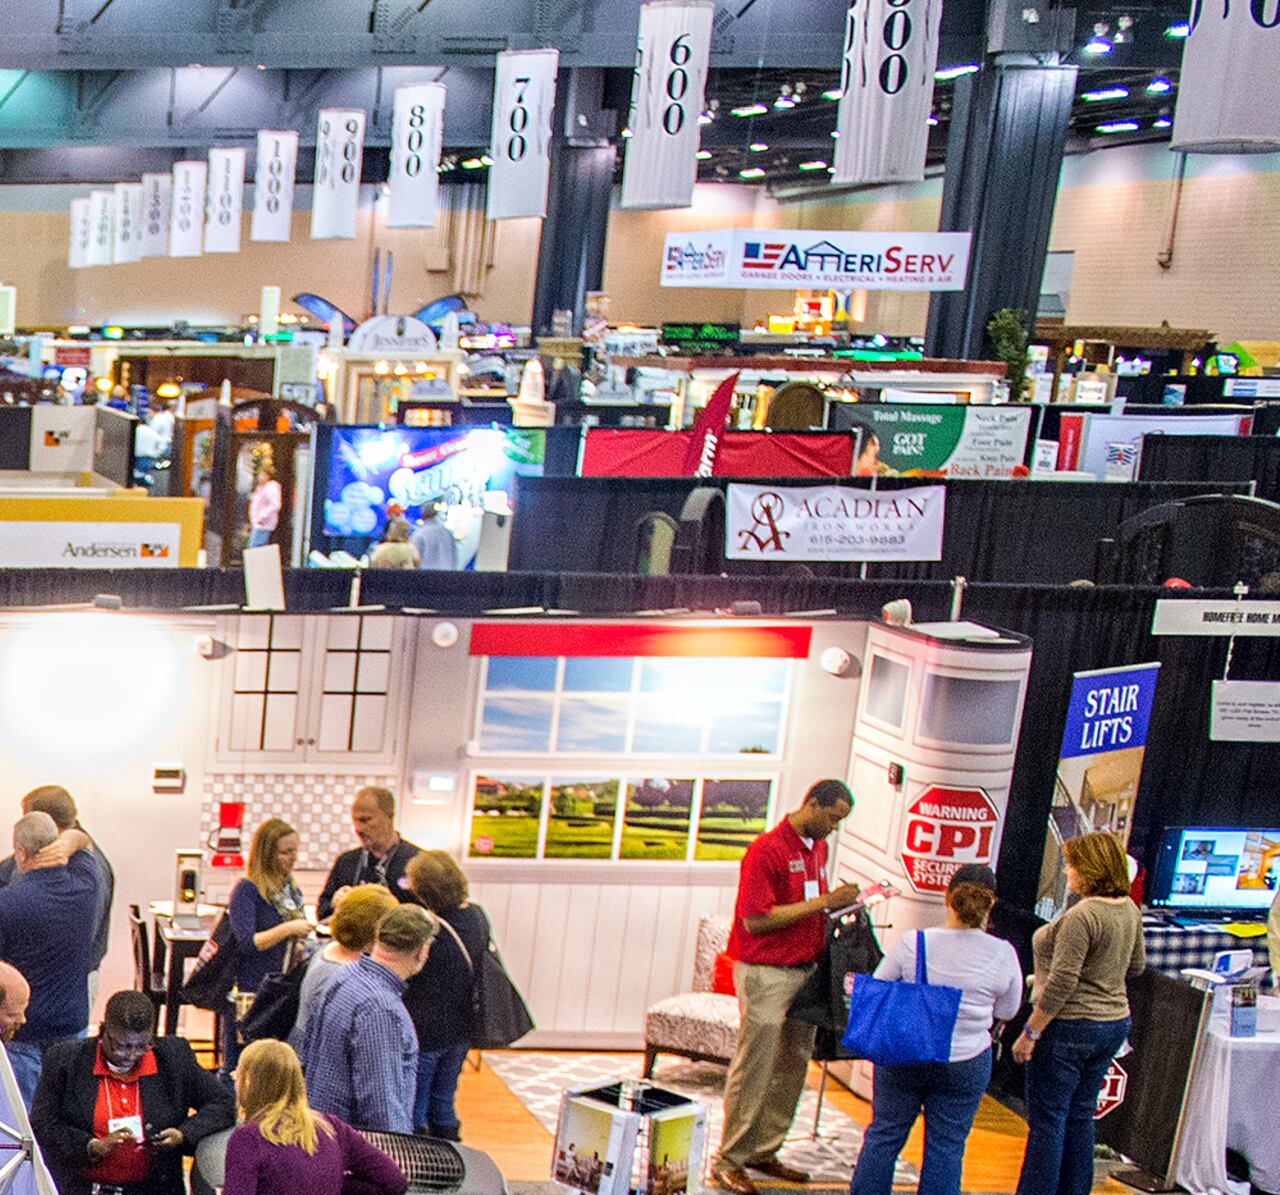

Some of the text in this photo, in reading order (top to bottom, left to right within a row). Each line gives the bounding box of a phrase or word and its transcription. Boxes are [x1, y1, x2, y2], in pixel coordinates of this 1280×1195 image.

[662, 33, 691, 136] 600
[506, 77, 532, 163] 700
[406, 103, 427, 178] 800
[796, 497, 928, 518] ACADIAN
[61, 541, 138, 559] Andersen
[1084, 684, 1141, 718] STAIR
[1080, 716, 1133, 750] LIFTS
[918, 801, 988, 820] WARNING
[906, 818, 993, 858] CPI
